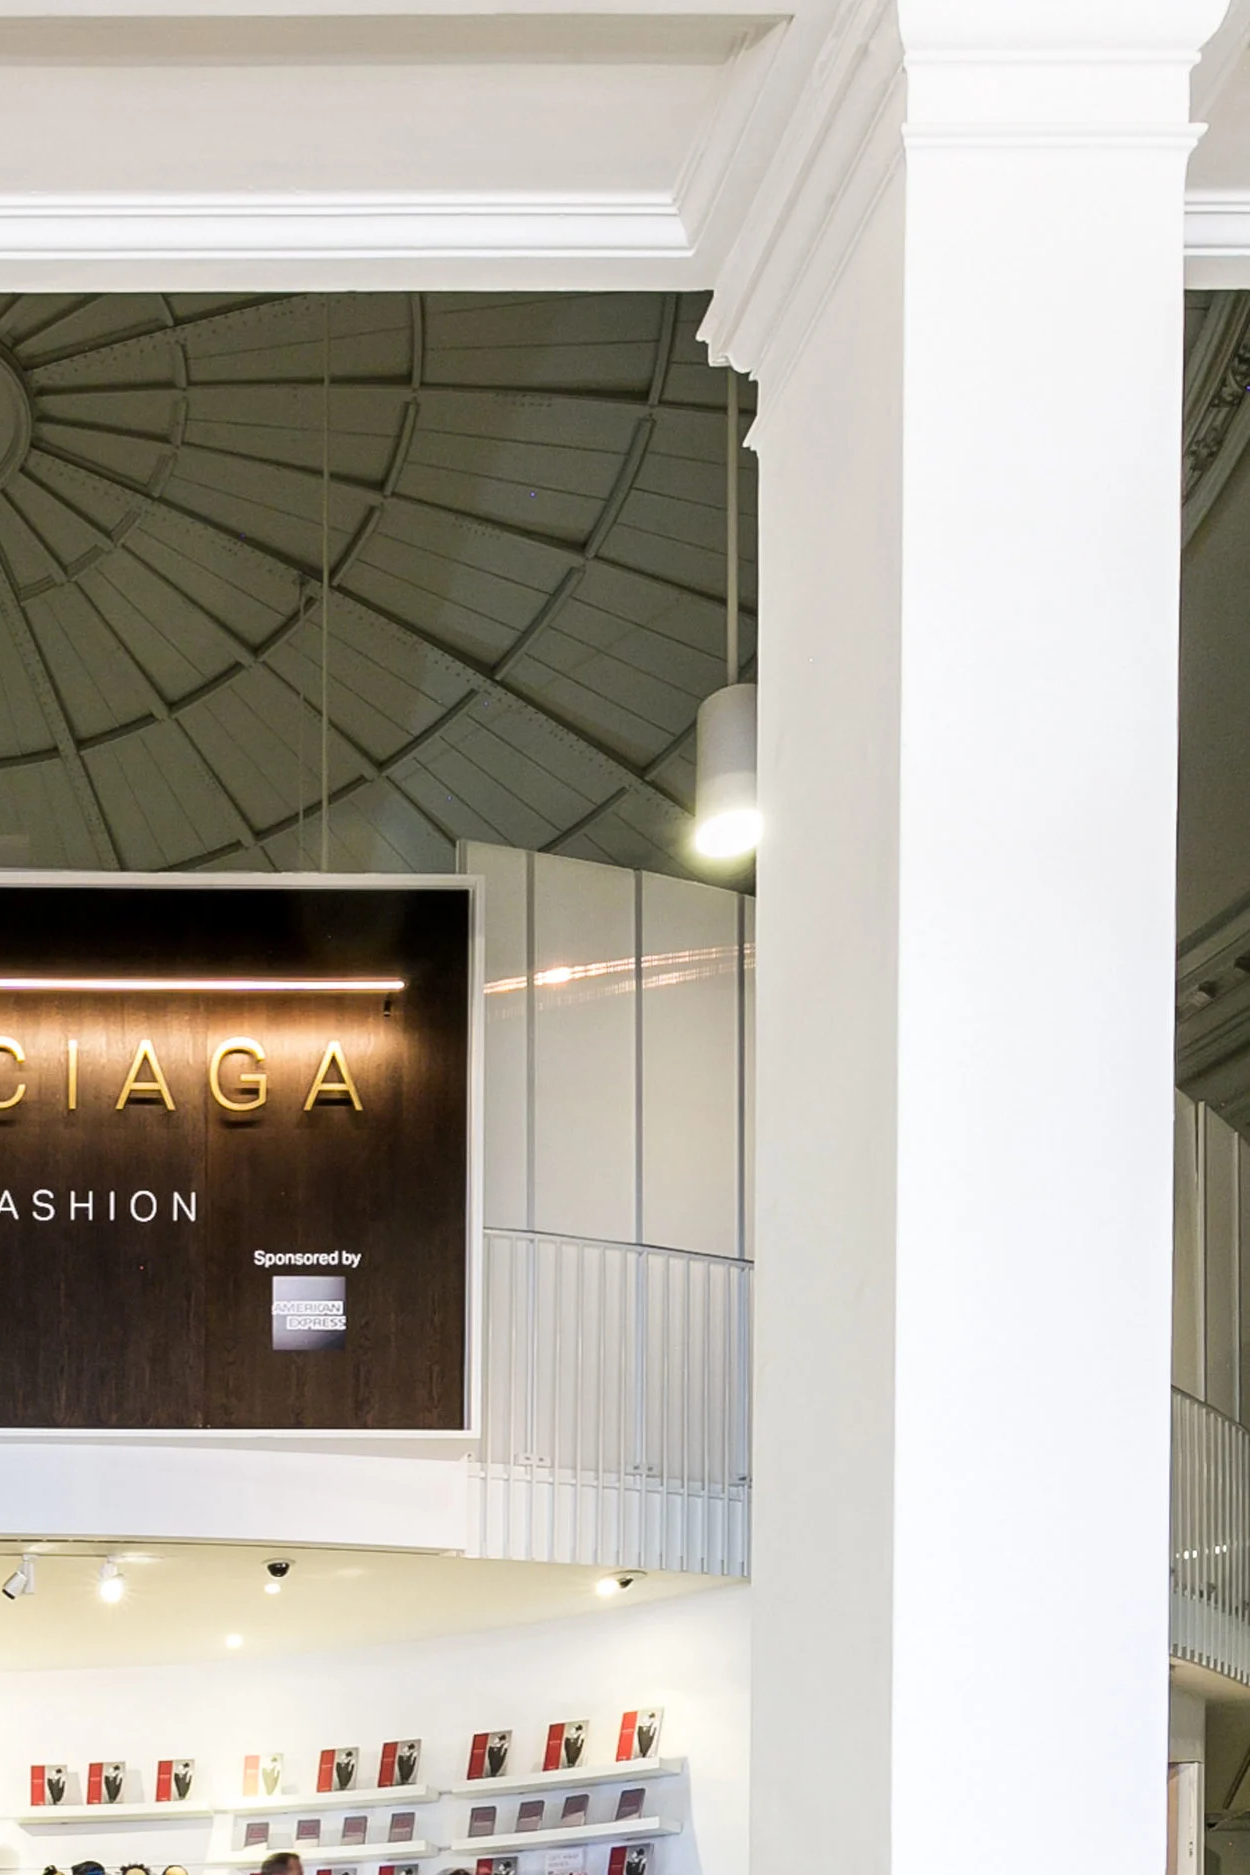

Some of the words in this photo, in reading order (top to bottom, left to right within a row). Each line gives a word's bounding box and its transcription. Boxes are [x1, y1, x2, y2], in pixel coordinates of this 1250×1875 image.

[253, 1250, 339, 1268] Sponsored
[341, 1250, 362, 1268] by
[273, 1301, 343, 1315] AMERICAN
[287, 1316, 347, 1330] EXPRESS
